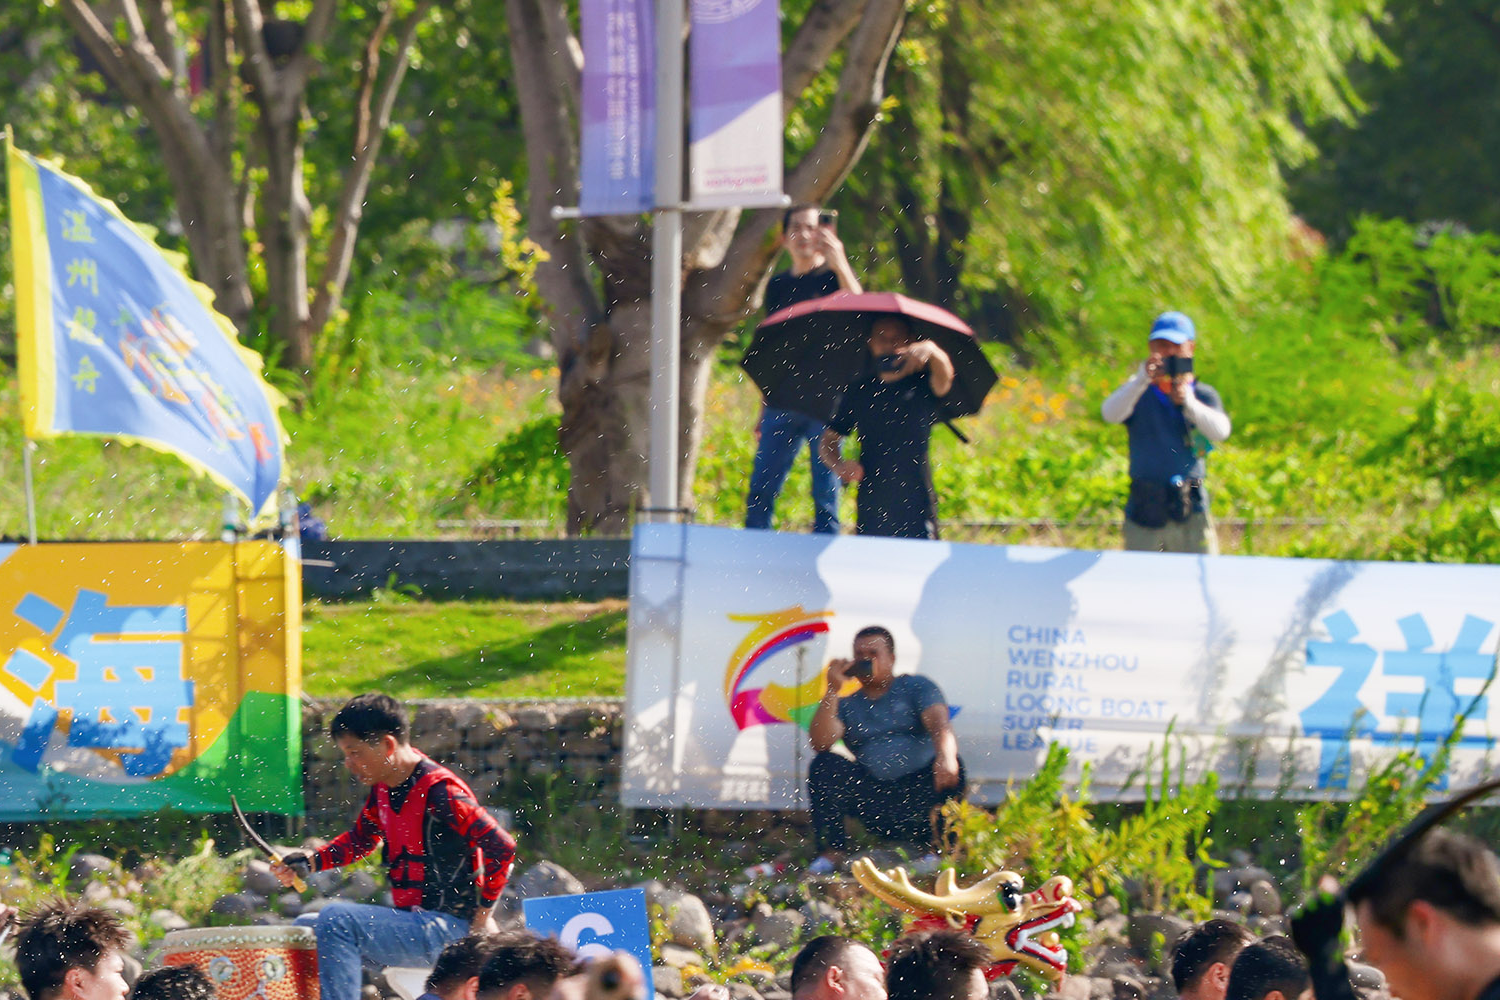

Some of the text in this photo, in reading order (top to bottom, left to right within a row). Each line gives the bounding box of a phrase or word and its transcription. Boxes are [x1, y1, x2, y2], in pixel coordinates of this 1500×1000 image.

[1007, 624, 1086, 645] CHINA
[1007, 647, 1139, 672] WENZHOU
[1006, 669, 1088, 692] RURAL
[1101, 697, 1168, 719] BOAT
[1298, 609, 1496, 793] 祥
